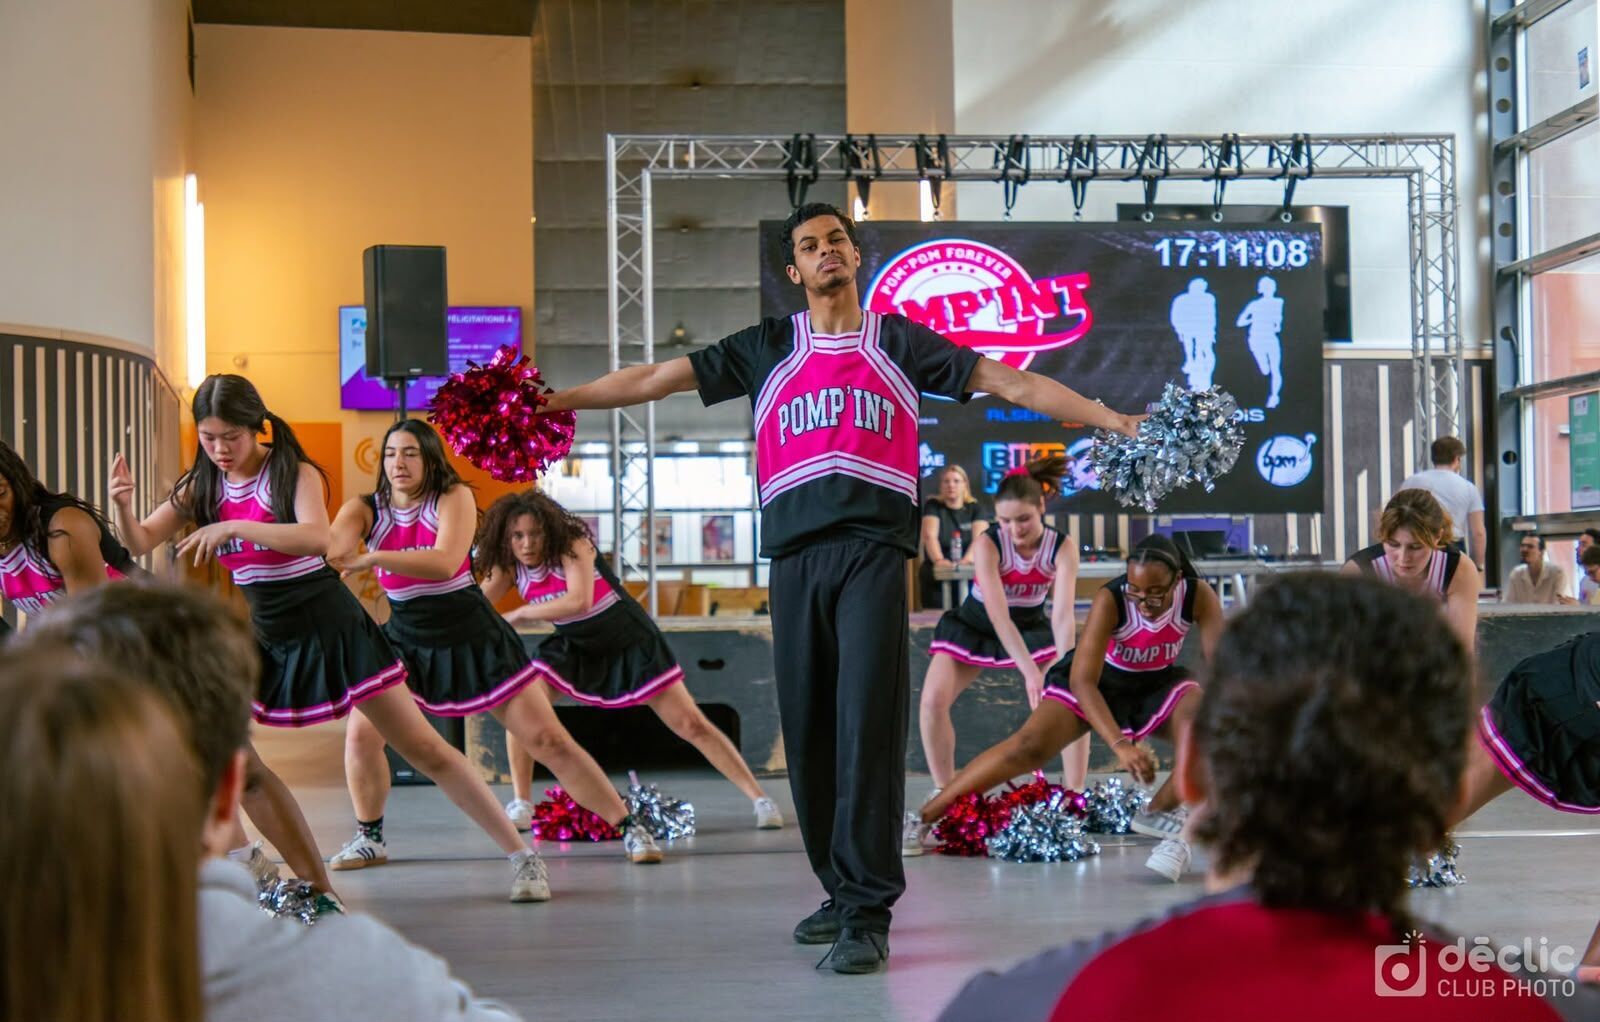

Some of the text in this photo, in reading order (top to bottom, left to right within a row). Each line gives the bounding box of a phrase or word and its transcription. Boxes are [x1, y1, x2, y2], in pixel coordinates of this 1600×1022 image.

[880, 247, 1012, 295] POM-POM FOREVER
[1155, 239, 1308, 267] 17:11:08
[898, 271, 1091, 334] MP'INT
[778, 385, 895, 446] POMP'INT
[1111, 637, 1185, 663] POMP'IN
